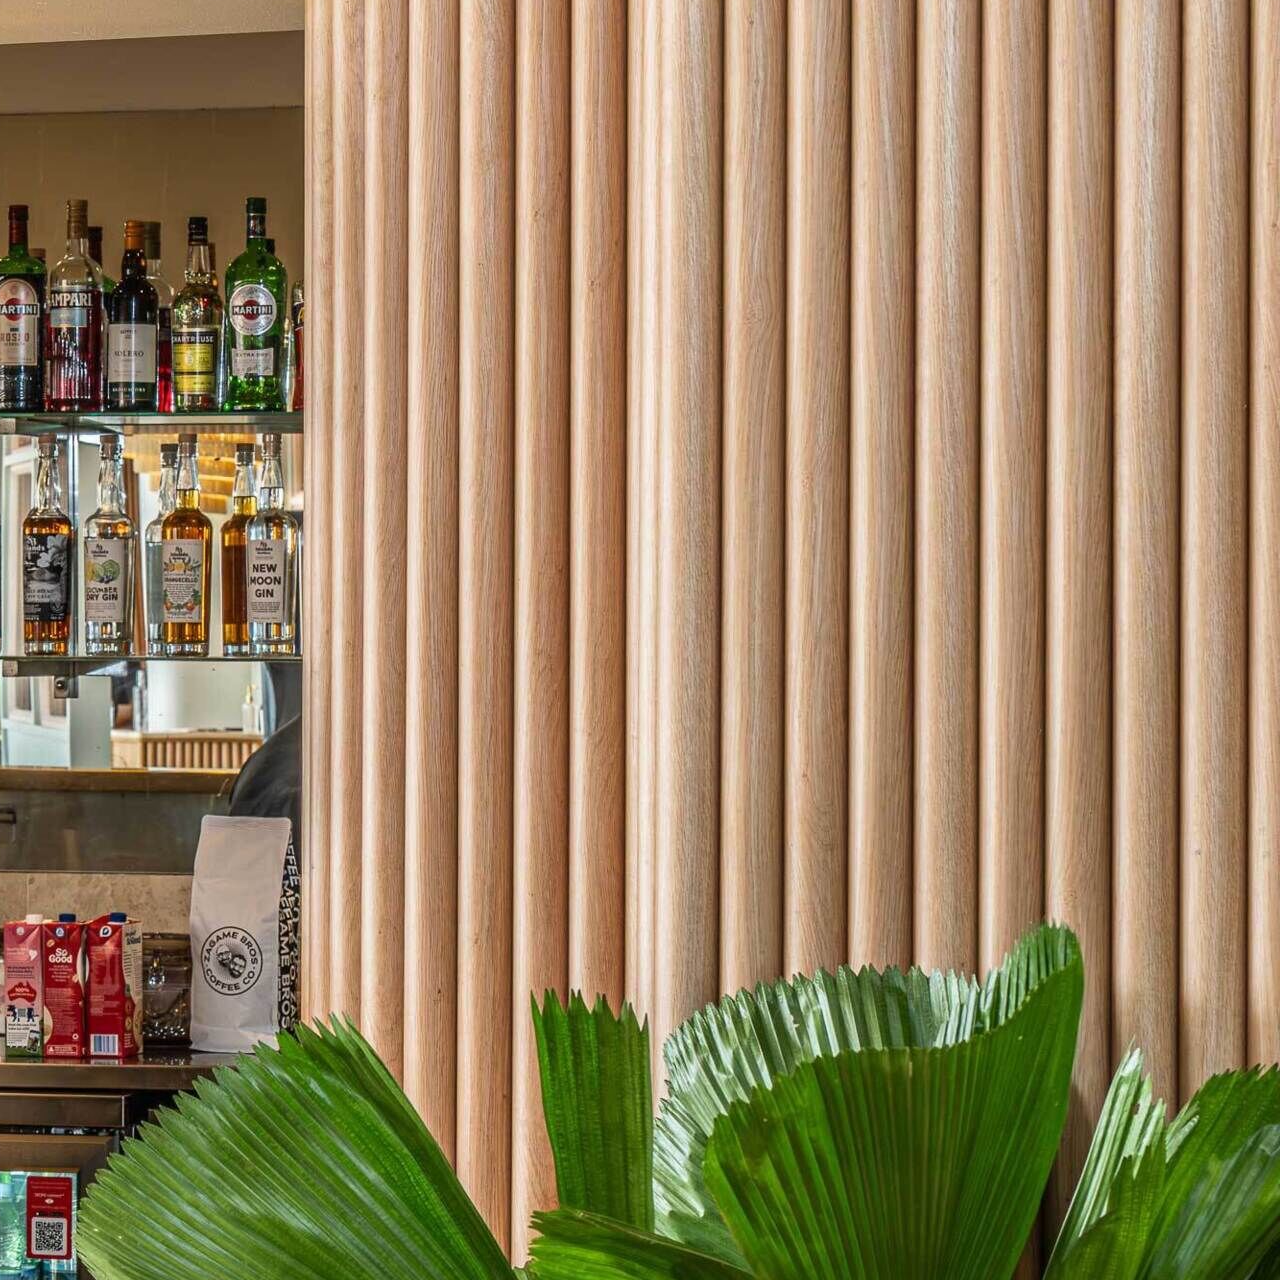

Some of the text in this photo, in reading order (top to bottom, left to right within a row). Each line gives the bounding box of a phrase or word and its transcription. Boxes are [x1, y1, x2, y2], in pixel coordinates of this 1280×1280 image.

[233, 305, 273, 315] MARTINI
[171, 335, 215, 343] CHARTRUSE
[252, 563, 277, 573] NEW
[249, 576, 282, 586] MOON
[102, 593, 119, 602] GIN
[255, 588, 275, 598] GIN
[55, 948, 68, 956] So
[204, 930, 240, 963] ZAGAME
[240, 935, 259, 966] BROS
[48, 955, 73, 964] Good
[205, 967, 241, 992] COFFEE
